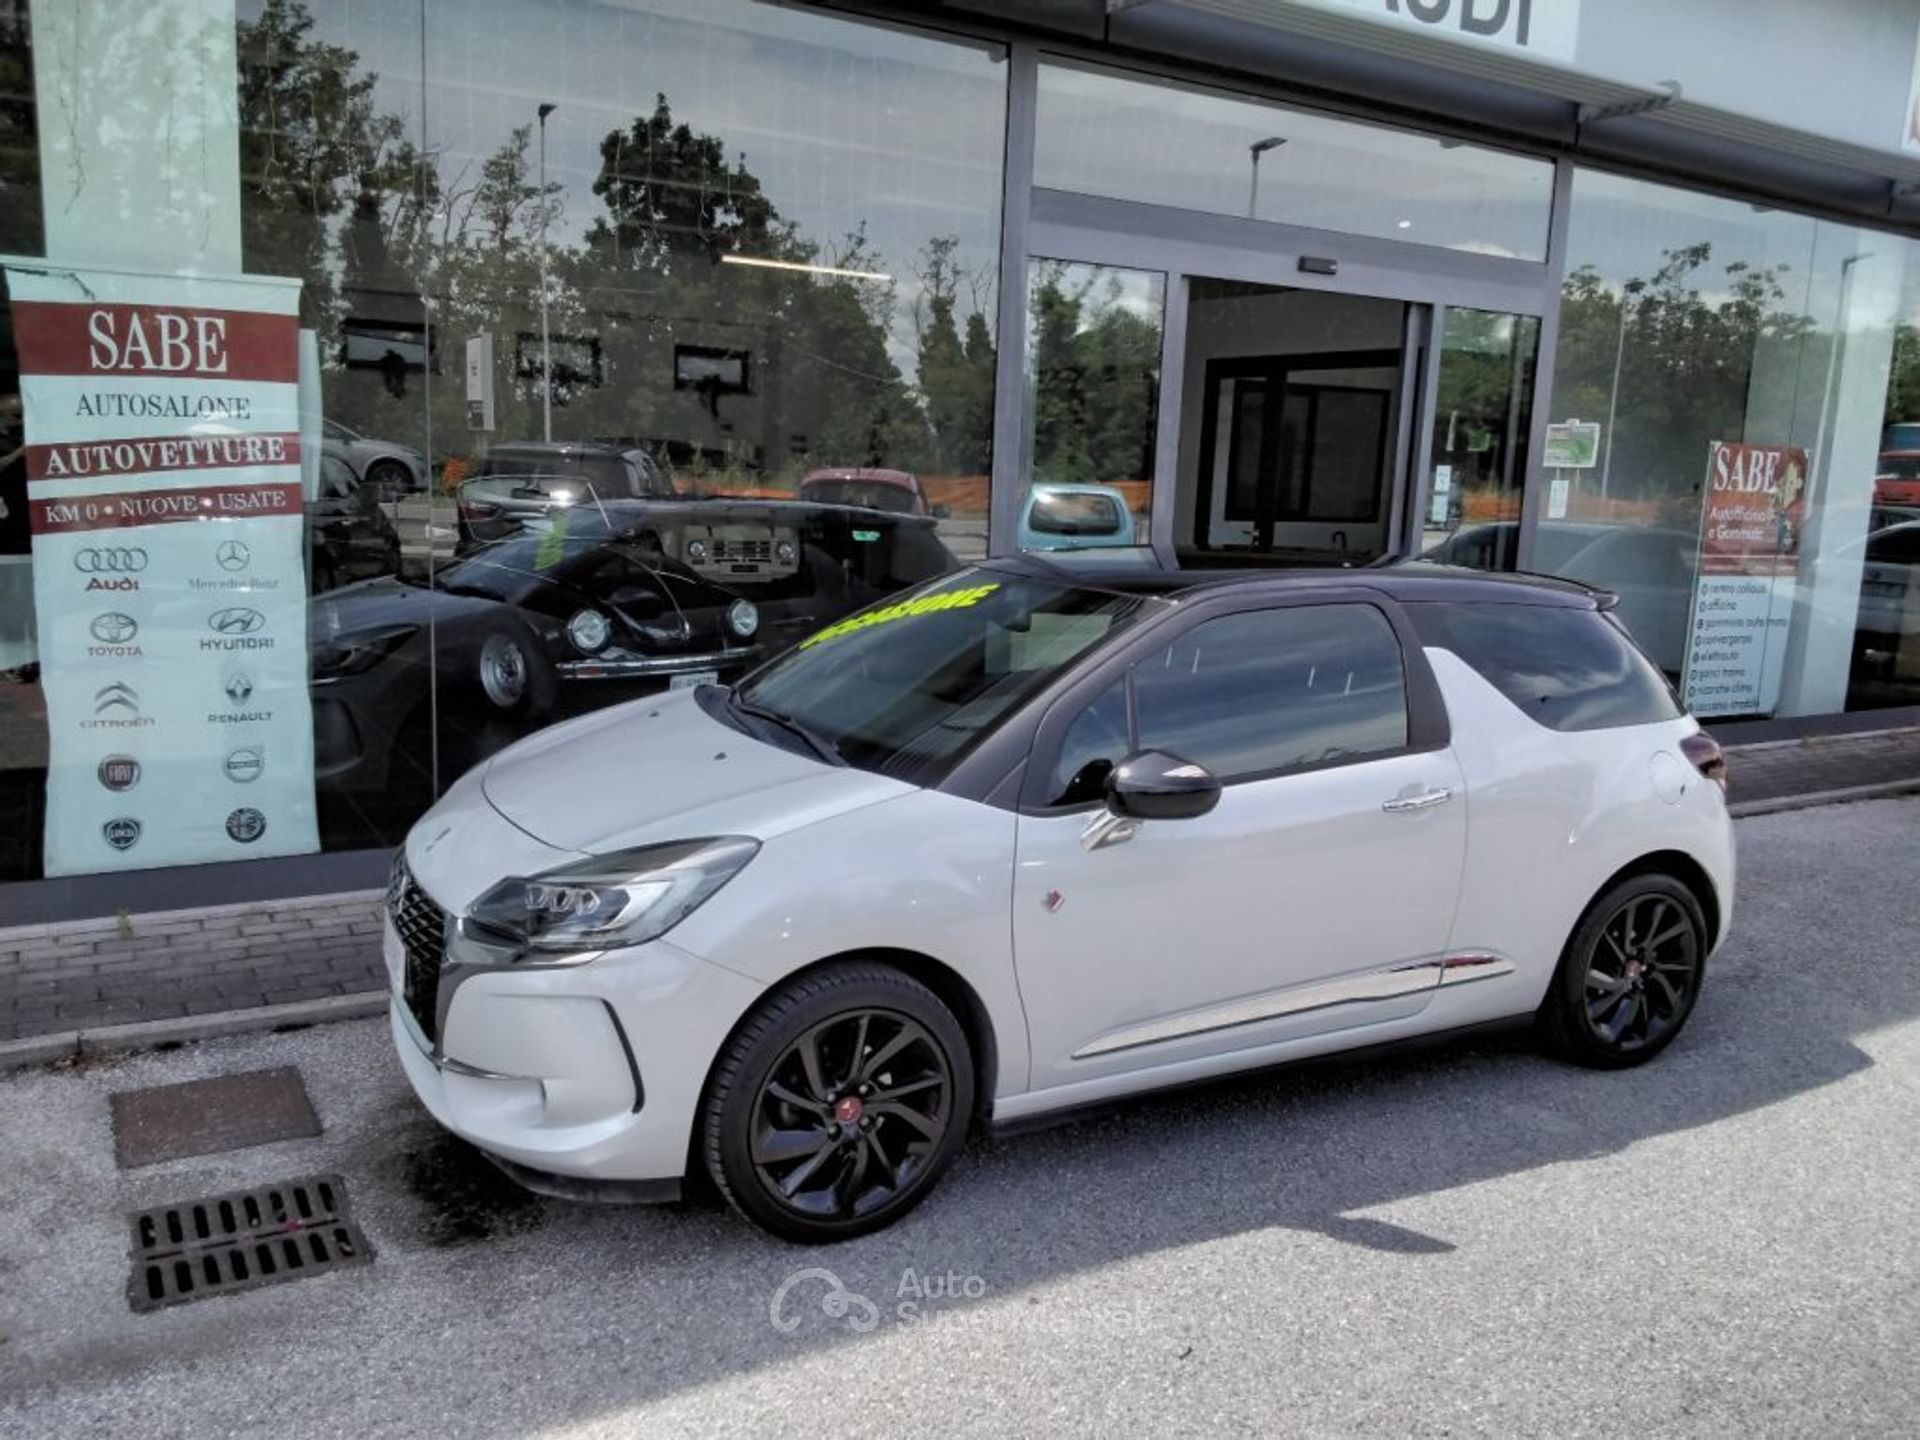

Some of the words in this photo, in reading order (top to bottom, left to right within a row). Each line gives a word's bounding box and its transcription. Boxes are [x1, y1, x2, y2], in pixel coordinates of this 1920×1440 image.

[88, 310, 228, 372] SABE
[76, 393, 251, 420] AUTOSALONE
[45, 436, 286, 476] AUTOVETTURE
[1713, 446, 1781, 494] SABE
[46, 504, 80, 524] KM
[120, 494, 200, 518] NUOVE
[217, 490, 287, 511] USATE
[85, 576, 140, 592] Audi
[88, 646, 143, 657] TOYOTA
[200, 637, 275, 651] HYUNDAI
[207, 712, 273, 723] RENAULT
